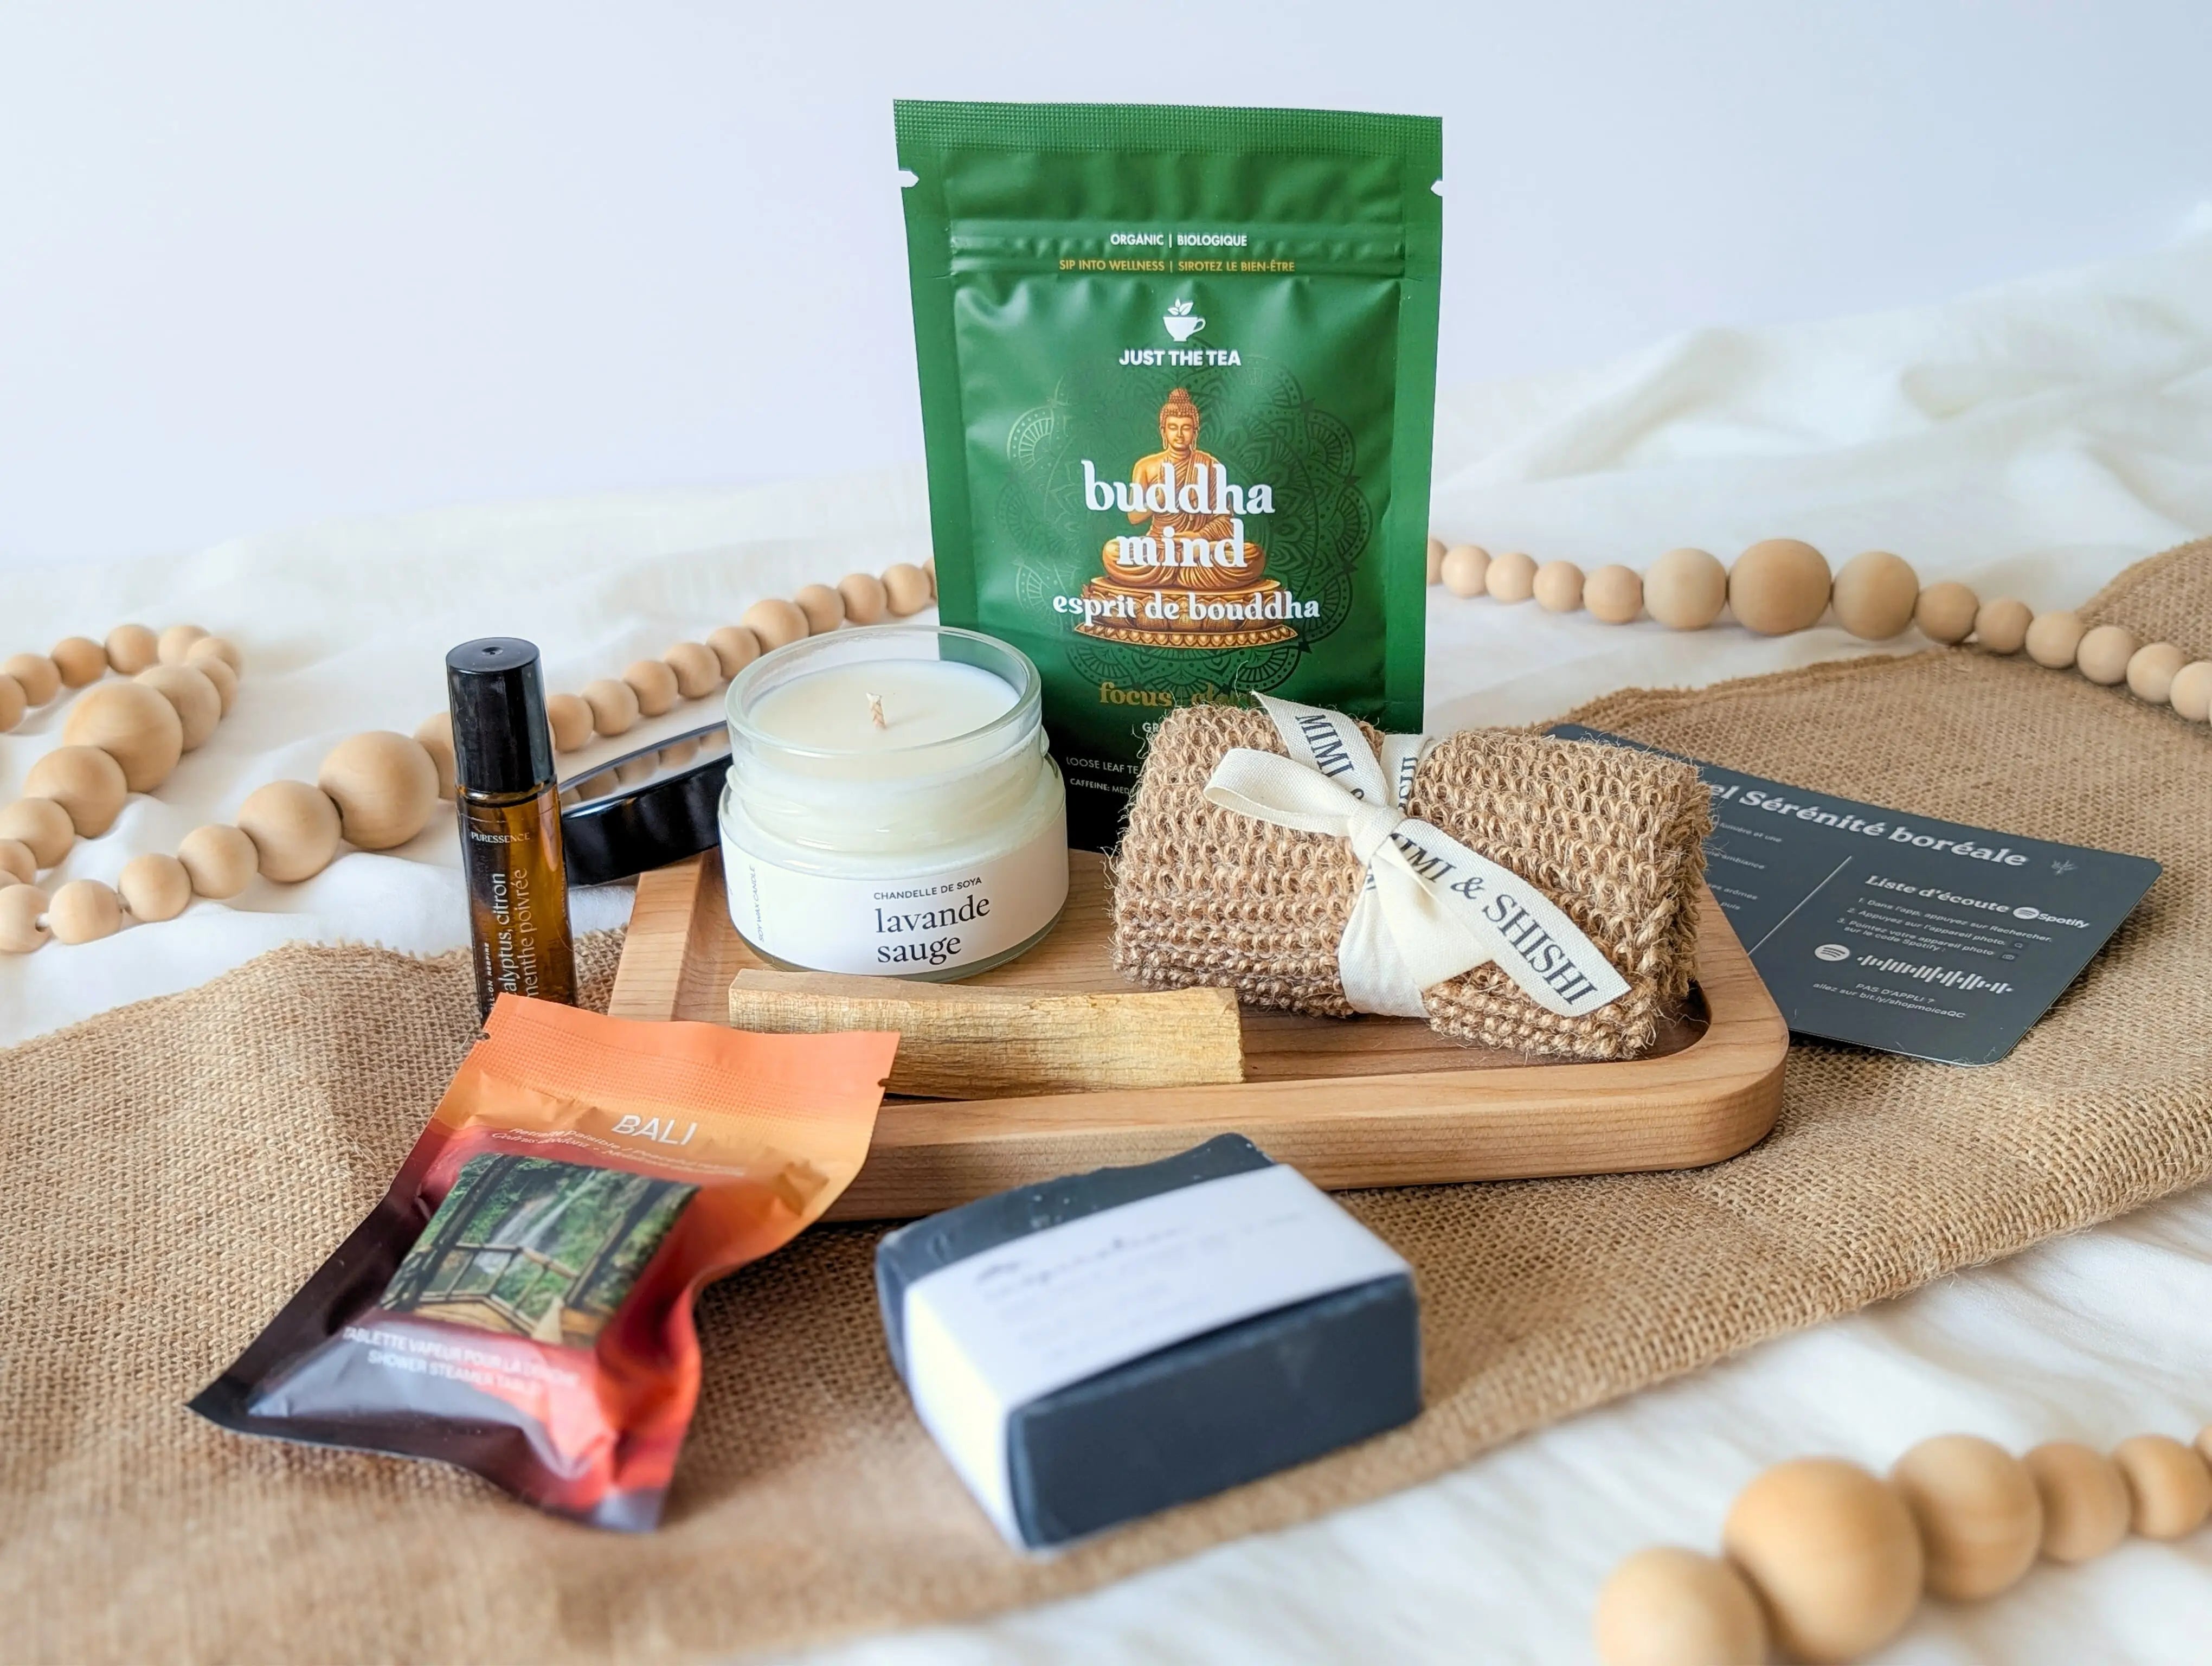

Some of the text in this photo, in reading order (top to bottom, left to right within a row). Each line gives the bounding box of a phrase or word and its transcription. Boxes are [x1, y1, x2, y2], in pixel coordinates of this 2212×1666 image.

[1110, 233, 1164, 246] ORGANIC
[1176, 234, 1248, 247] BIOLOGIQUE
[1059, 260, 1076, 271] SIP
[1079, 260, 1106, 271] INTO
[1109, 260, 1165, 271] WELLNESS
[1178, 260, 1223, 272] SIROTEZ
[1226, 261, 1237, 272] LE
[1240, 259, 1295, 272] BIEN-ÊTRE
[1119, 349, 1242, 367] JUST THE TEA
[1081, 459, 1276, 515] buddha
[1116, 518, 1248, 568] mind
[1053, 590, 1321, 627] esprit de bouddha
[1098, 681, 1173, 707] focus
[1142, 722, 1159, 733] GR
[1295, 714, 1354, 778] MIMI
[1066, 757, 1139, 774] LOOSE LEAF TE
[1070, 778, 1130, 794] CAFFEINE: MED
[471, 831, 531, 844] PURESSENCE
[1710, 784, 2029, 866] el Sérénité boréale
[1721, 855, 1765, 870] ambiance
[749, 863, 760, 902] CANDLE
[874, 876, 982, 901] CHANDELLE DE SOYA
[510, 868, 538, 933] poivrée
[874, 895, 991, 934] lavande
[1865, 875, 2091, 929] Liste d'écoute Spotify
[1867, 899, 1893, 910] Dans
[1924, 913, 1968, 926] appuyez
[1970, 921, 1989, 930] sur
[1390, 832, 1457, 883] IMI
[1451, 876, 1484, 900] &
[1482, 893, 1598, 1005] SHISHI
[1858, 910, 1903, 925] Appuyez
[1924, 924, 1972, 939] l'appareil
[492, 873, 521, 995] alyptus, citron
[1848, 920, 1888, 933] Pointez
[1889, 930, 1917, 939] votre
[1918, 935, 1962, 949] appareil
[1874, 933, 1900, 943] code
[1901, 938, 1940, 952] Spotify
[877, 936, 962, 966] sauge
[1812, 982, 1838, 992] allez
[1839, 988, 1859, 997] sur
[1855, 983, 1880, 993] PAS
[1880, 988, 1925, 1003] D'APPLI
[611, 1114, 698, 1146] BALI
